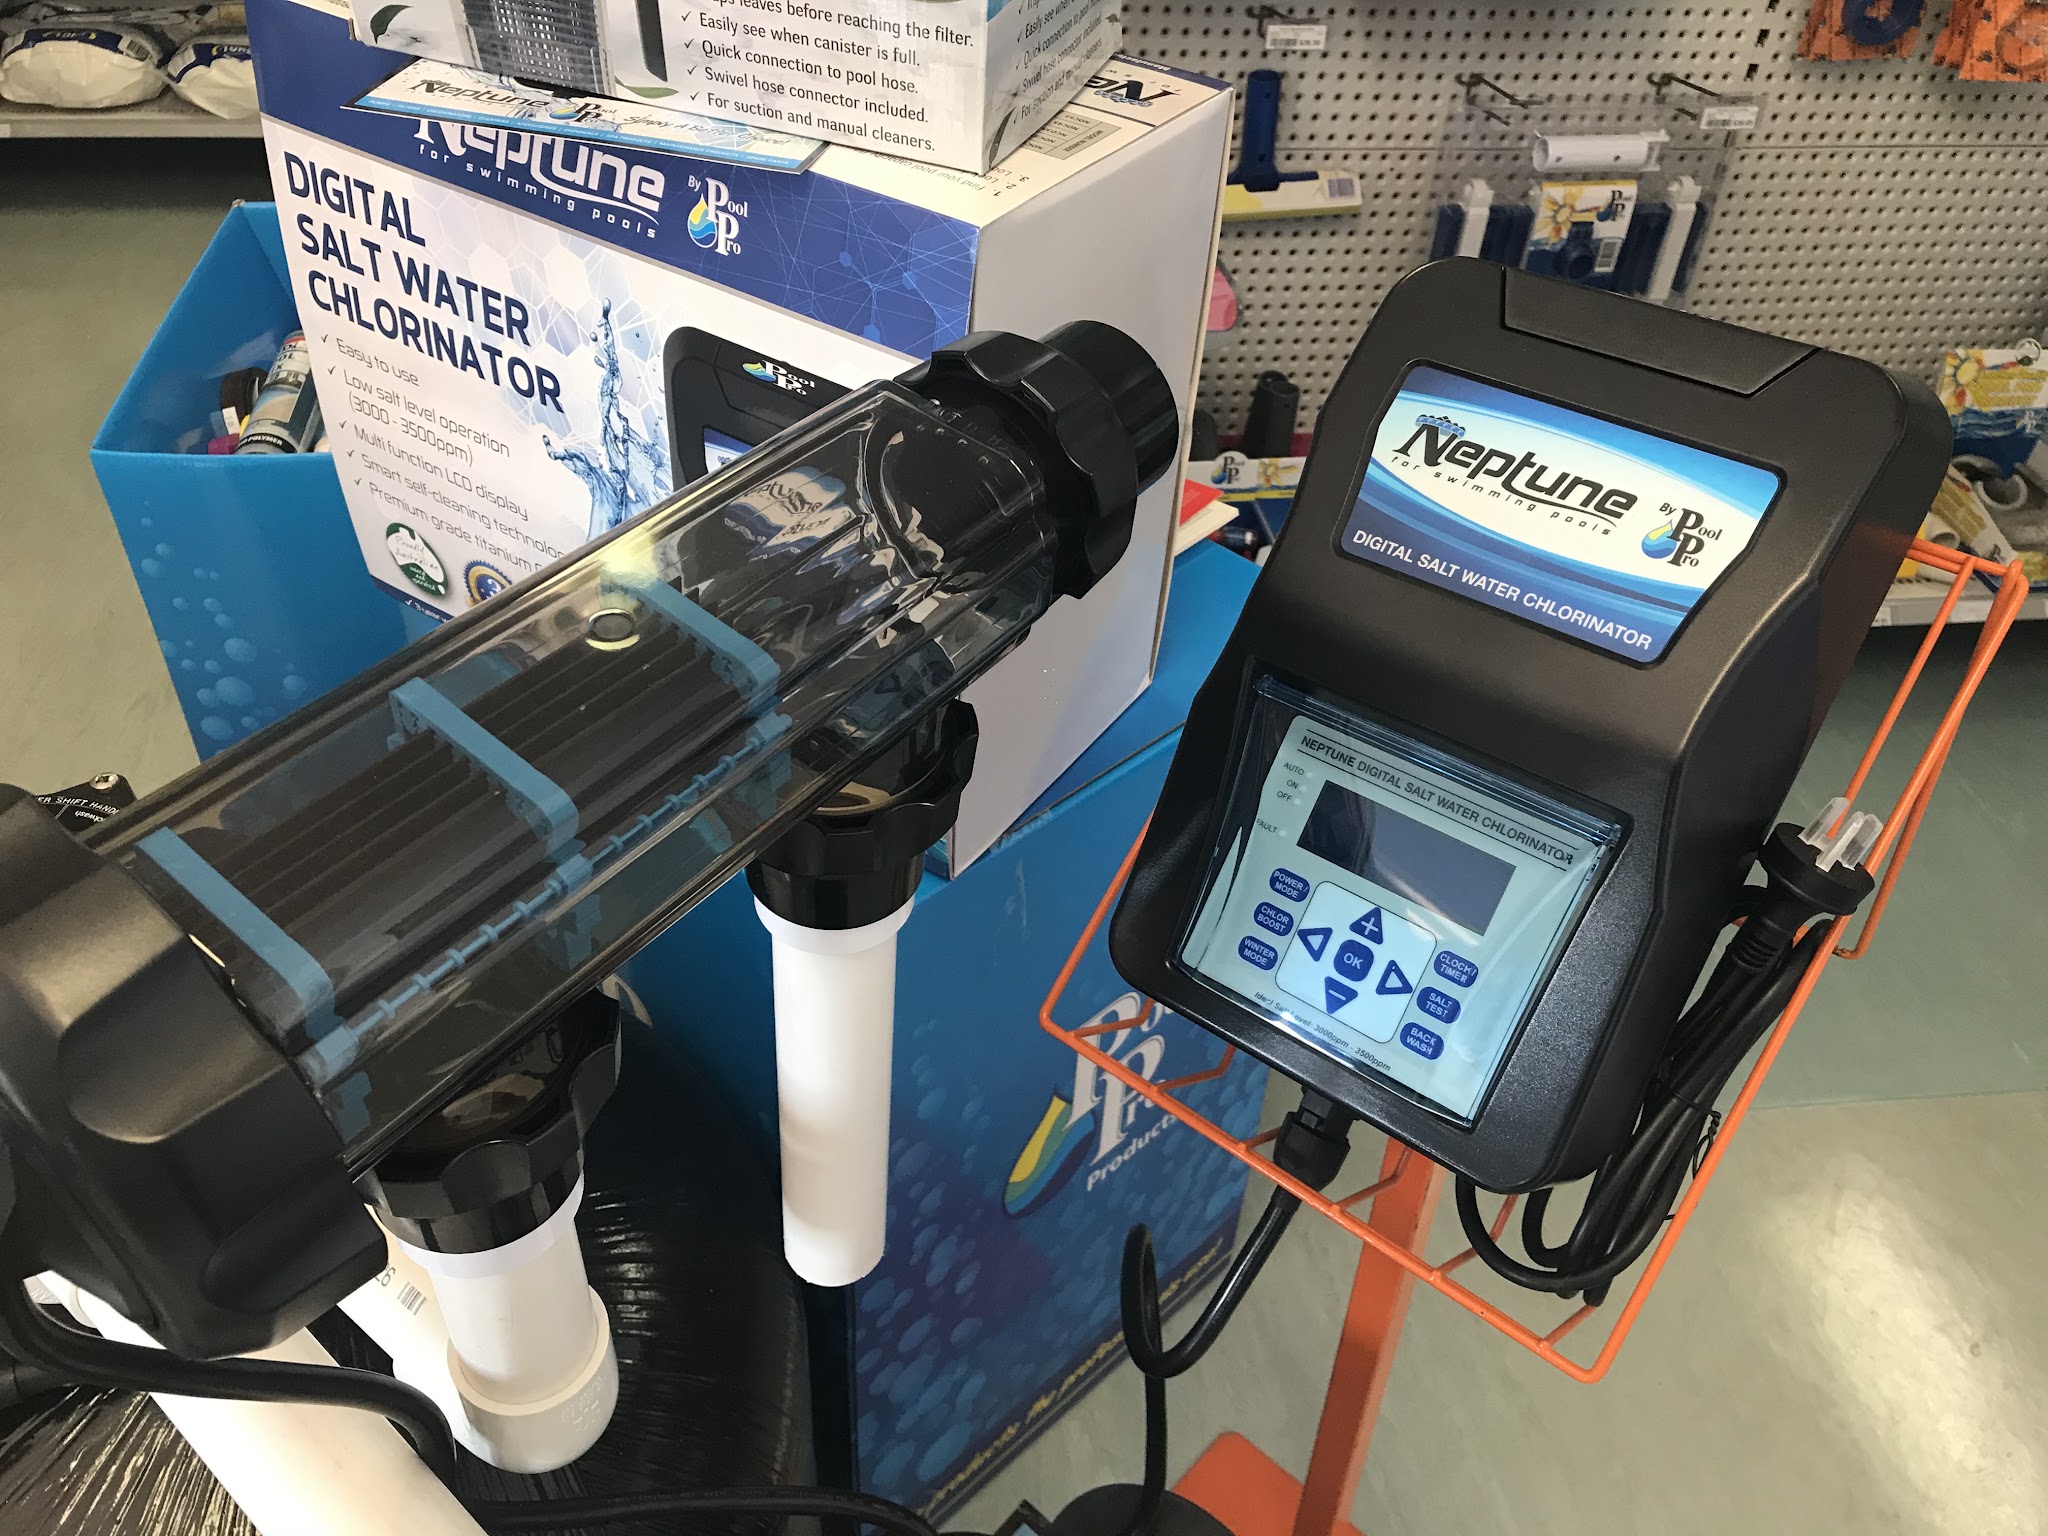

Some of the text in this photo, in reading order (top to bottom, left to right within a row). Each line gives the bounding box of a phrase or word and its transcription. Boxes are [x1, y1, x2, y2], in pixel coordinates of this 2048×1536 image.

[699, 12, 920, 66] Easily see when canister is full.
[787, 1, 833, 23] before
[837, 13, 900, 39] reaching
[905, 22, 930, 39] the
[935, 26, 974, 47] filter.
[702, 40, 918, 94] Quick connection to pool hose.
[409, 79, 550, 108] Neptune
[704, 67, 928, 123] Swivel hose connector included.
[707, 93, 935, 151] For suction and manual cleaners.
[284, 151, 426, 247] DIGITAL
[419, 144, 656, 239] for swimming pools
[687, 174, 702, 192] By
[705, 177, 748, 223] Pool
[714, 210, 742, 256] Pro
[297, 213, 531, 347] SALT WATER
[308, 270, 565, 414] CHLORINATOR
[336, 338, 420, 387] Easy to use
[762, 360, 816, 388] Pool
[343, 369, 511, 458] Low salt level operation
[348, 390, 390, 426] (3000
[400, 418, 474, 468] 3500ppm)
[354, 424, 529, 522] Multi function LCD display
[361, 454, 402, 485] Smart
[404, 475, 491, 530] self-cleaning
[1392, 421, 1638, 521] Neptune
[1391, 456, 1611, 536] for swimming pools
[1659, 502, 1677, 516] By
[369, 482, 532, 573] Premium grade titanium
[1666, 508, 1723, 542] Pool
[1666, 532, 1705, 567] Pro
[1352, 529, 1653, 650] DIGITAL SALT WATER CHLORINATOR
[1283, 762, 1305, 776] AUTO
[1286, 779, 1299, 790] ON
[55, 796, 89, 806] SHIFT
[1276, 790, 1292, 802] OFF
[1301, 736, 1574, 866] NEPTUNE DIGITAL SALT WATER CHLORINATOR
[1274, 881, 1299, 899] MODE
[1256, 913, 1286, 933] BOOST
[1261, 905, 1290, 925] CHLOR
[1243, 948, 1268, 967] MODE
[1244, 938, 1276, 960] WINTER
[1343, 952, 1364, 970] OK
[1440, 963, 1468, 984] TIMER
[1425, 1001, 1449, 1018] TEST
[1429, 992, 1453, 1008] SALT
[1313, 1024, 1350, 1049] 3000ppm
[1354, 1048, 1392, 1072] 3500ppm
[1406, 1035, 1433, 1055] WASH
[1410, 1027, 1437, 1046] BACK
